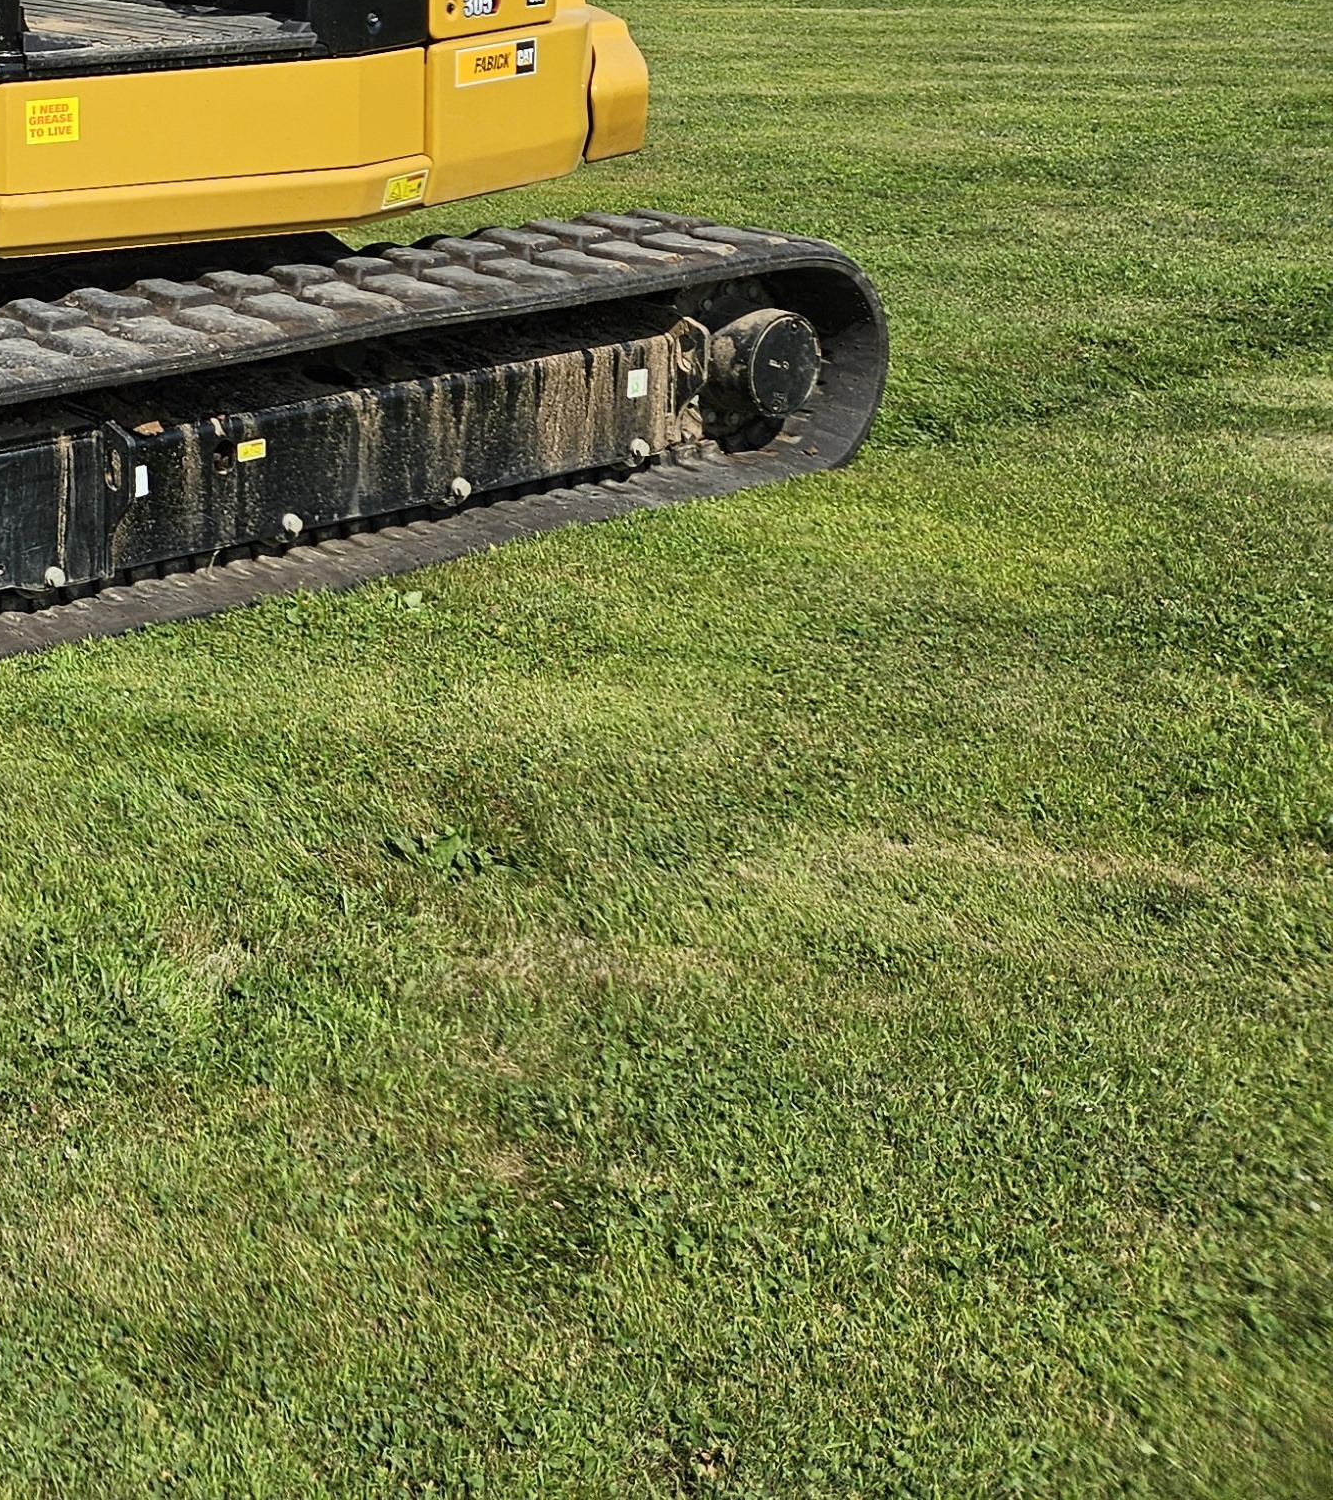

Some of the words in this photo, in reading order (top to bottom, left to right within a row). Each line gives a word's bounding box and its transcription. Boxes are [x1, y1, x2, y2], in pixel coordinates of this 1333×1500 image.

[474, 52, 512, 74] FABICK
[517, 48, 534, 66] CAT
[32, 105, 36, 115] I
[40, 104, 69, 114] NEED
[29, 113, 73, 125] GREASE
[29, 128, 44, 138] TO
[48, 126, 73, 136] LIVE
